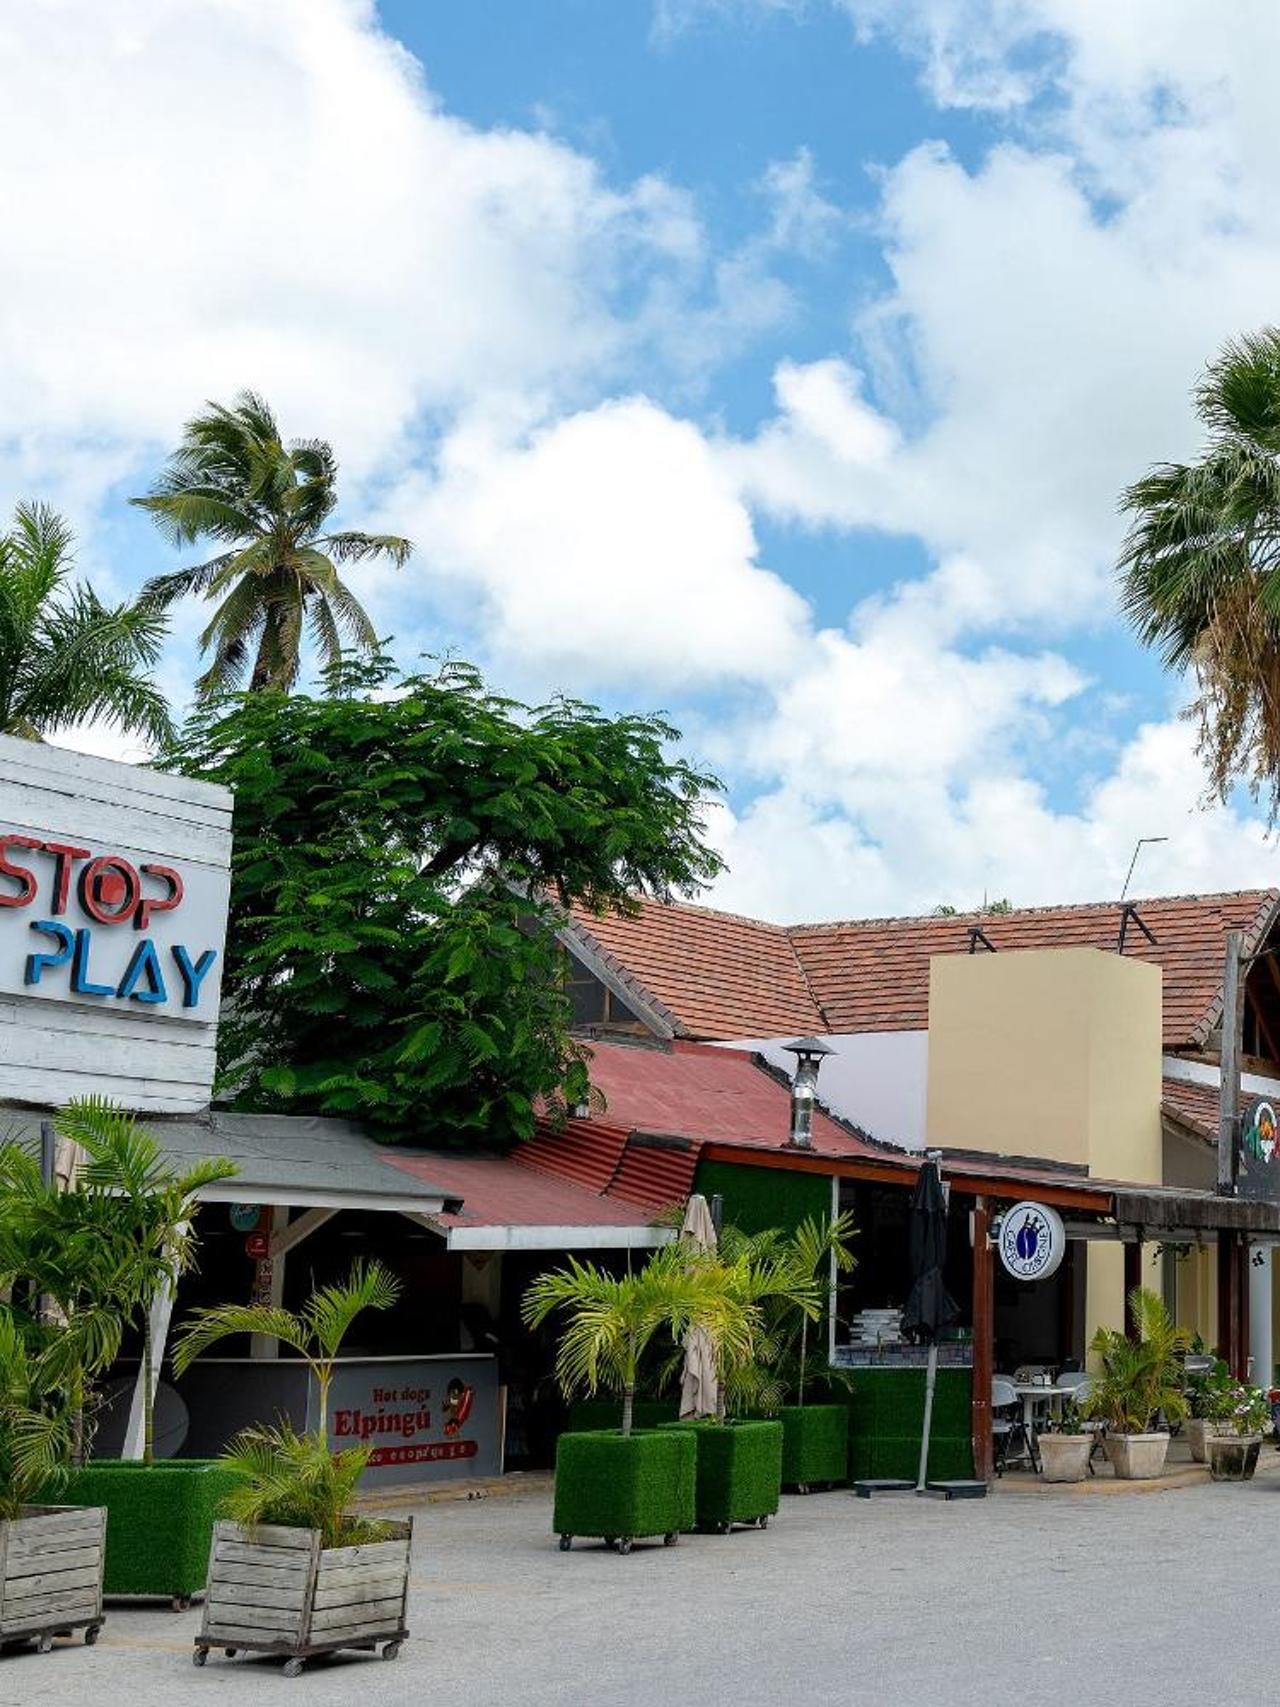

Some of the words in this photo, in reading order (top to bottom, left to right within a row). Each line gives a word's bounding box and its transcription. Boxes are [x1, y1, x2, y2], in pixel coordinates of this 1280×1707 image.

[0, 835, 185, 930] STOP
[25, 921, 218, 1008] PLAY
[373, 1388, 397, 1403] Hot
